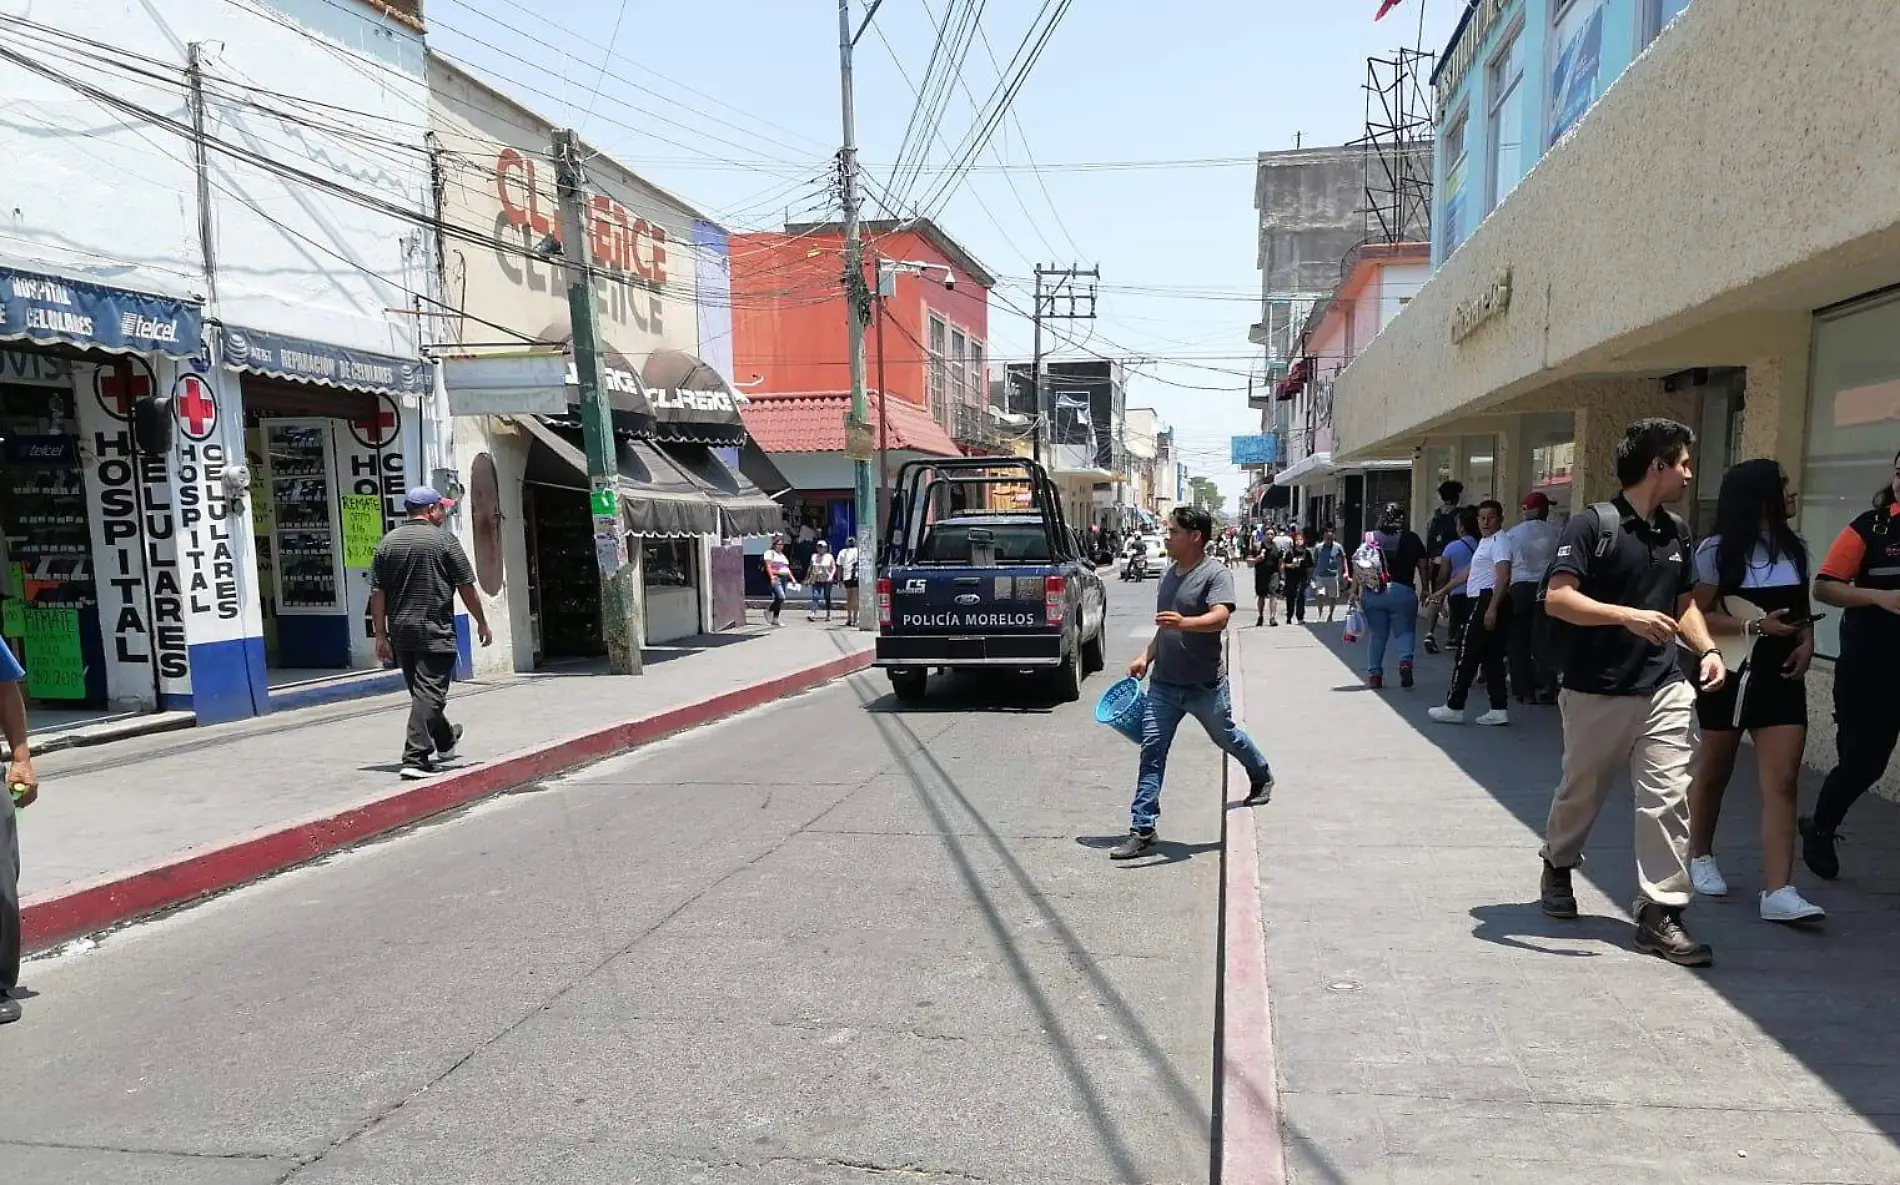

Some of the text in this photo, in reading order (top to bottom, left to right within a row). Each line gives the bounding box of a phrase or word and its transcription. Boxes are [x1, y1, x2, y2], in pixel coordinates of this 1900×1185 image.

[12, 276, 72, 305] HOSPITAL
[26, 307, 94, 337] CELULARES
[136, 315, 178, 342] telcel
[95, 431, 150, 664] HOSPITAL
[140, 454, 188, 679] ELULARES
[179, 443, 212, 614] HOSPITAL
[203, 443, 239, 620] CELULARES
[903, 611, 1035, 626] POLICÍA MORELOS
